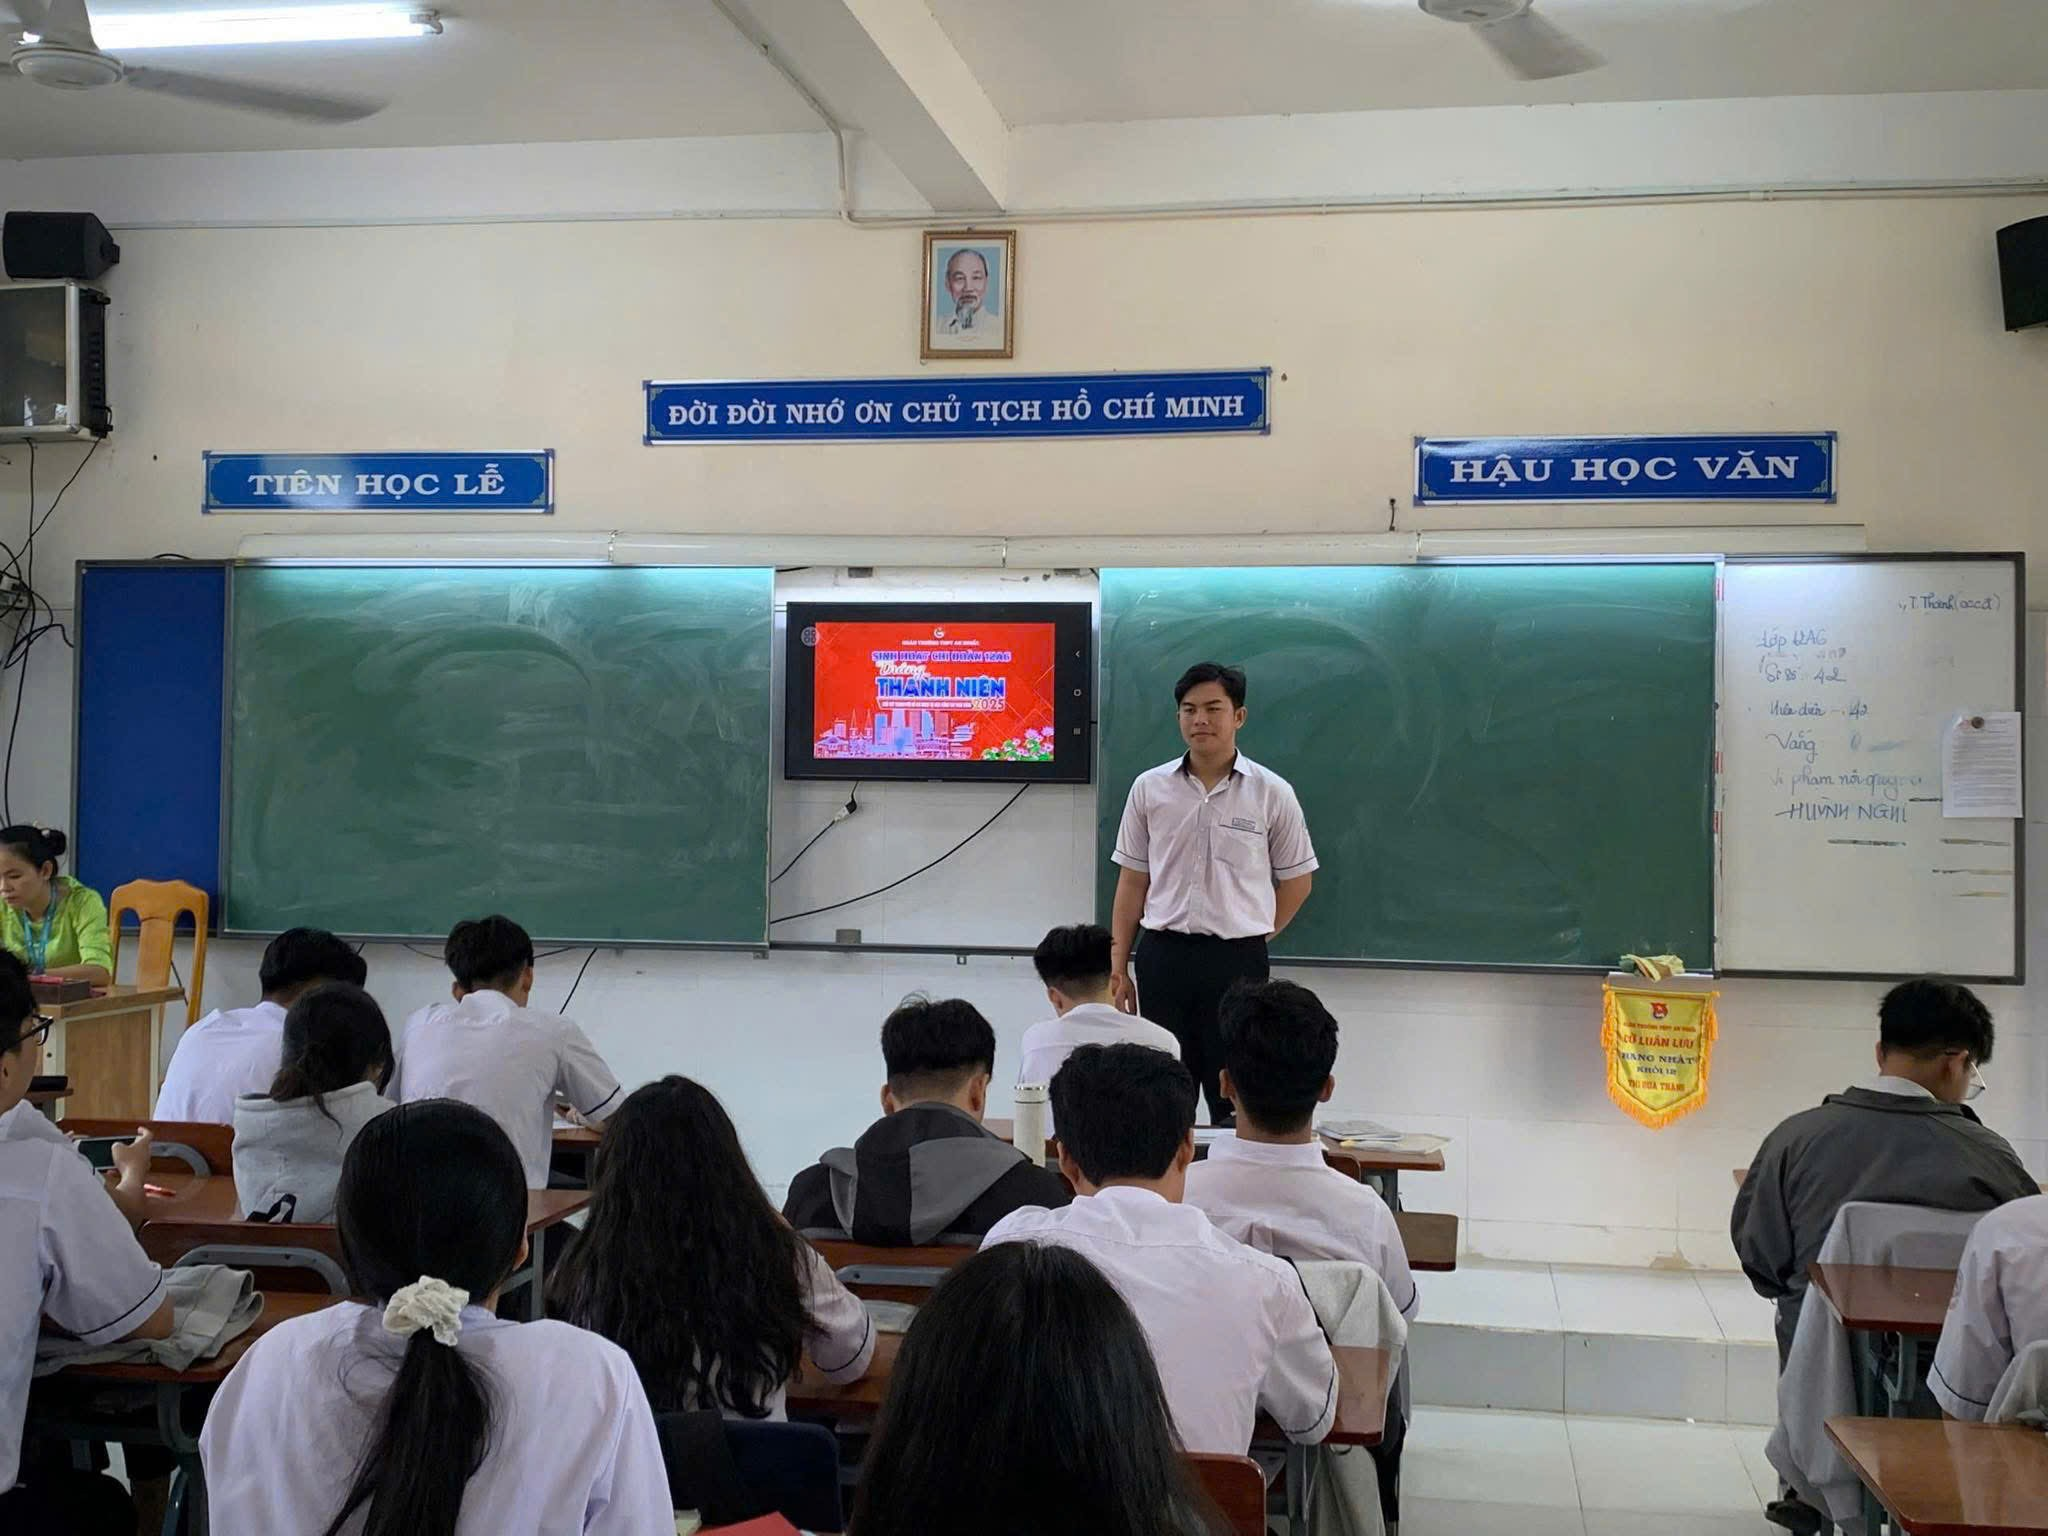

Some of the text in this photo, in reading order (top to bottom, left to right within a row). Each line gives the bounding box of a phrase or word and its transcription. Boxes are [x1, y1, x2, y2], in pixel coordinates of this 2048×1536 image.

[668, 388, 1244, 426] ĐỜI ĐỜI NHỚ ƠN CHỦ TỊCH HỒ CHÍ MINH
[355, 474, 440, 500] HỌC
[454, 463, 506, 496] LỄ
[1449, 450, 1799, 487] HẬU HỌC VĂN
[876, 675, 1006, 698] THANH NIÊN
